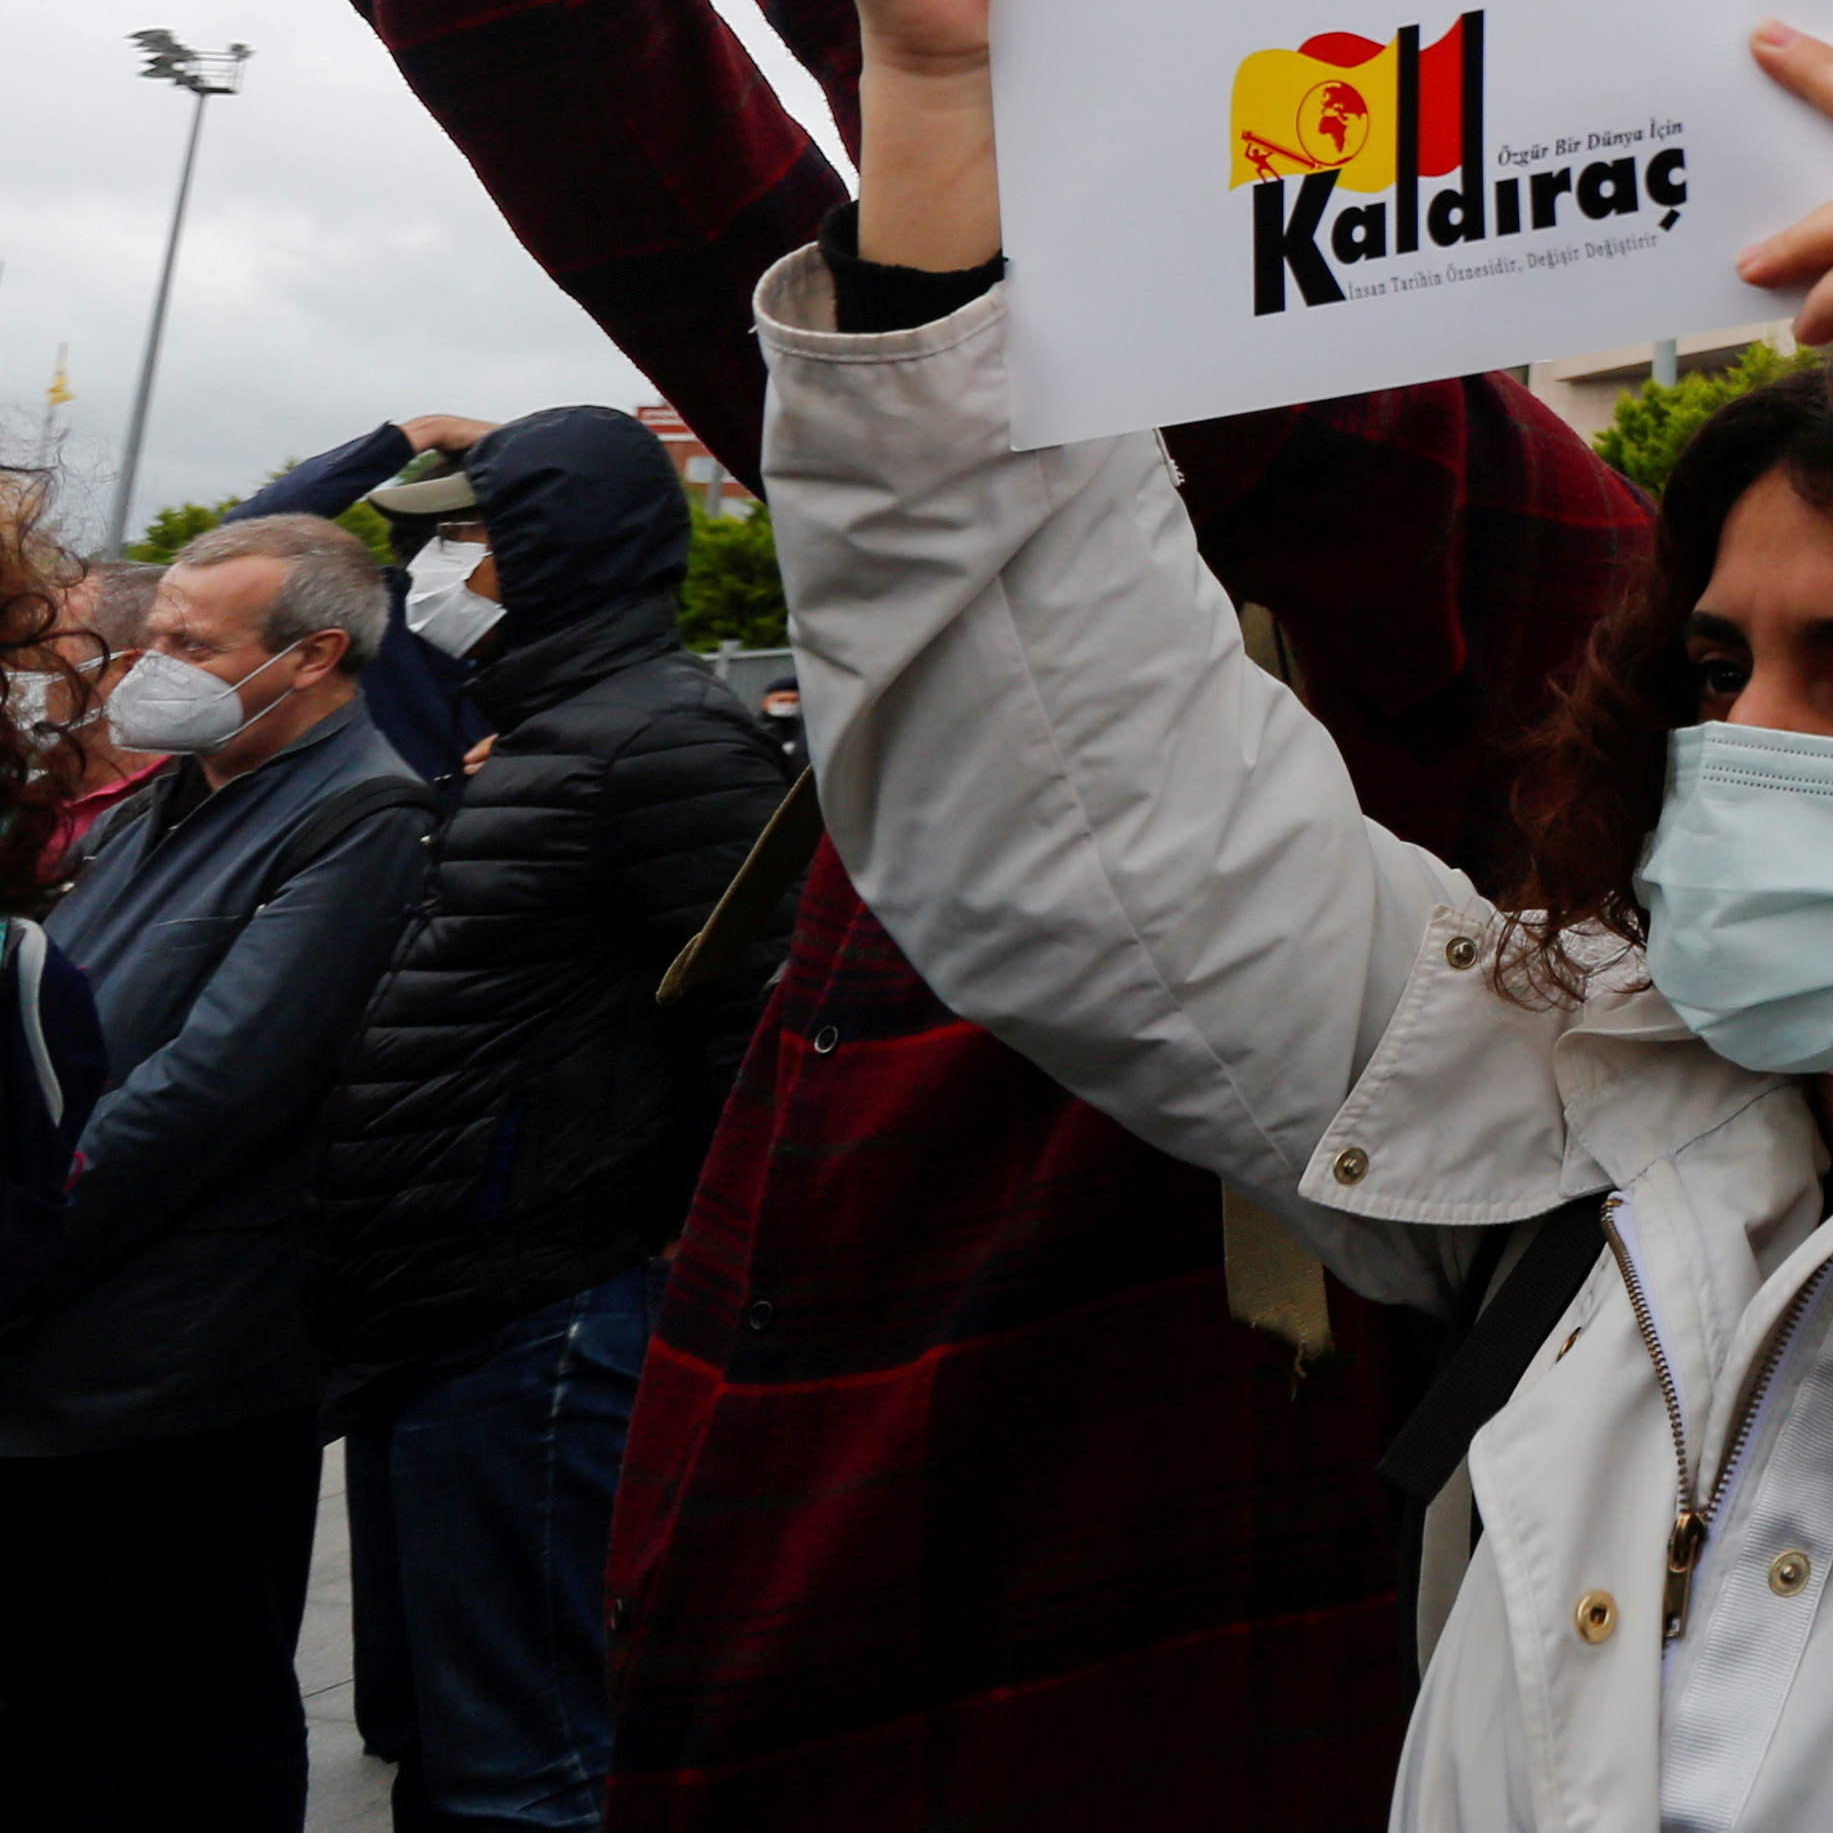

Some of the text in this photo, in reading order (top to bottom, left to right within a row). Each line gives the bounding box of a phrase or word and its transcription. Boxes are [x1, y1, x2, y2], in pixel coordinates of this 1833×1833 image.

[1253, 9, 1688, 316] Kaldıraç
[1497, 118, 1684, 167] Özgür Bir Dünya İçin
[1391, 271, 1442, 293] Tarihin
